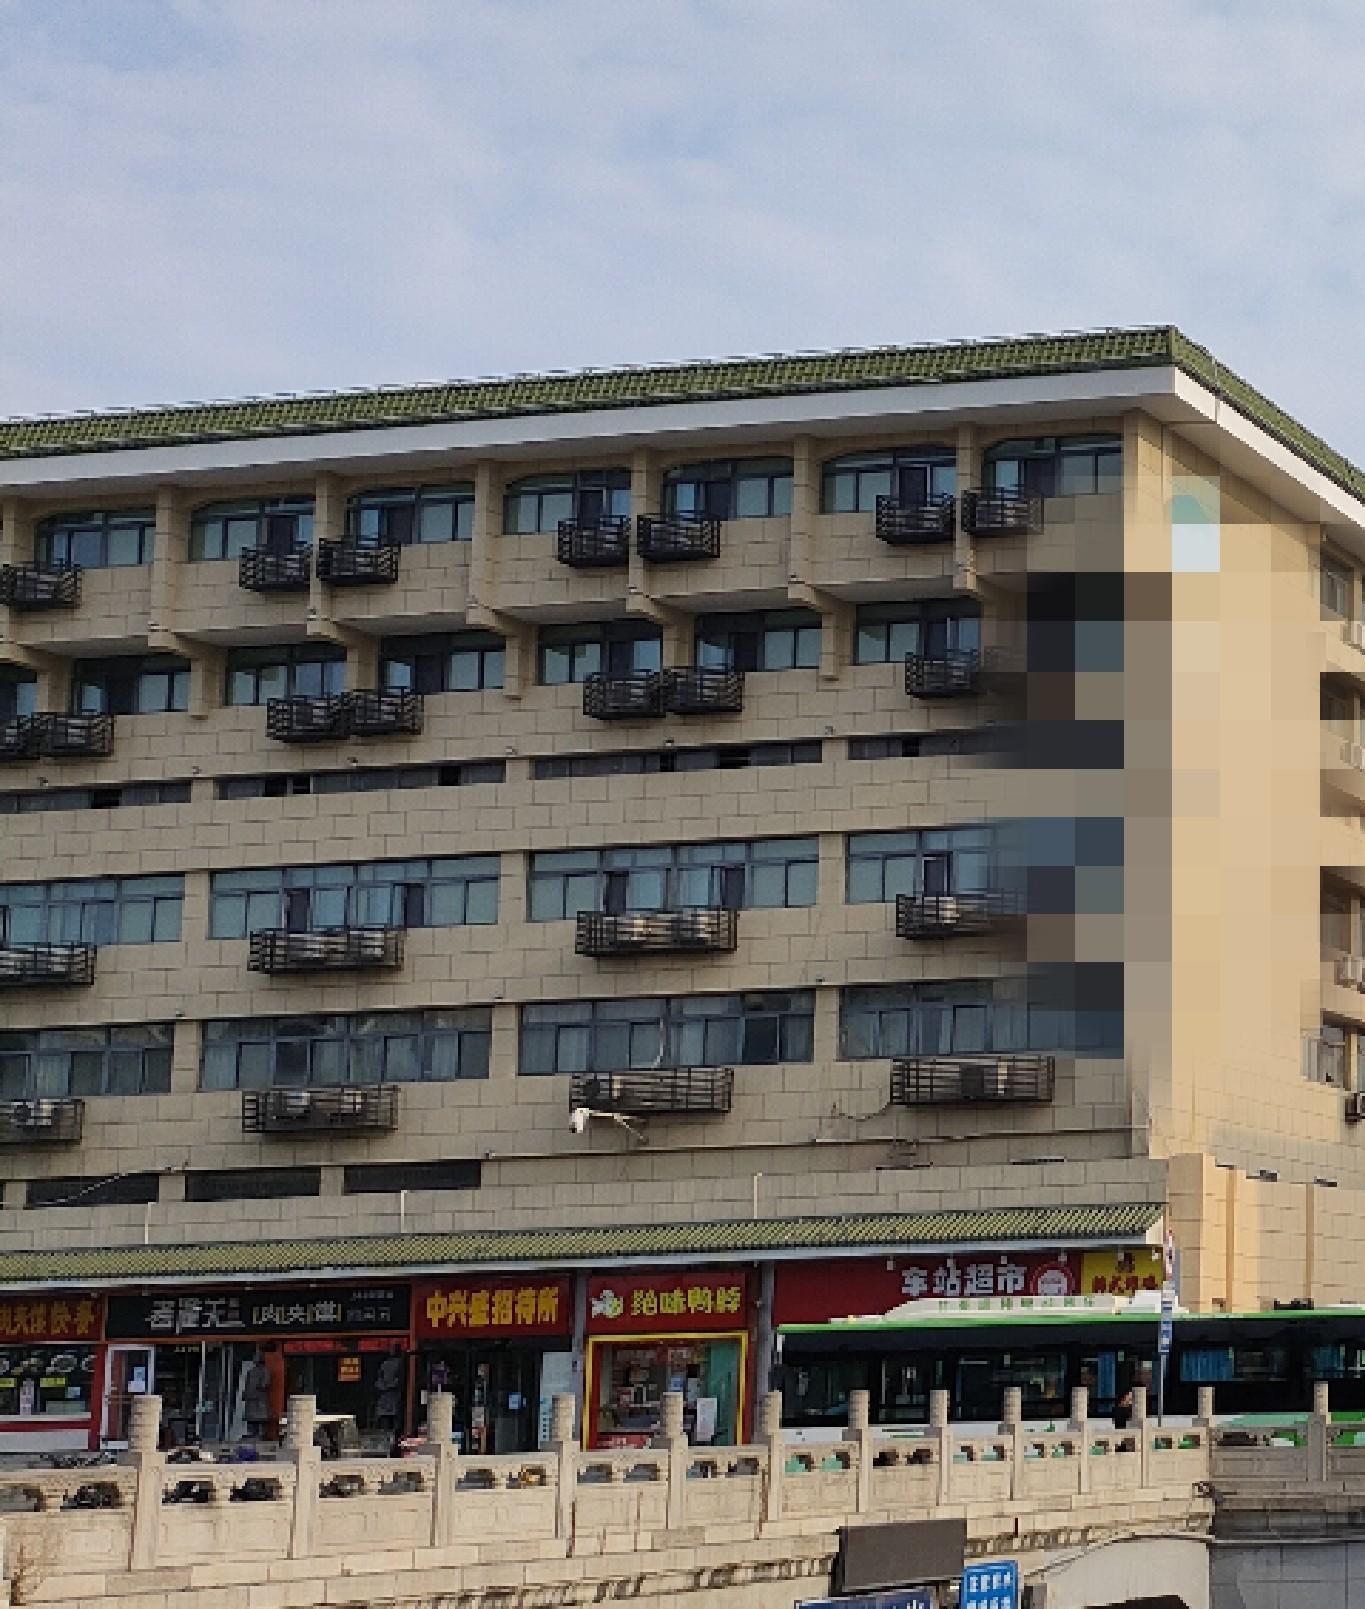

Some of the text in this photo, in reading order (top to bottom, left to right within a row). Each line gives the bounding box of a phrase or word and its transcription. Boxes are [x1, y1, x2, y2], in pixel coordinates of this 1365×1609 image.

[901, 1263, 1028, 1297] 车站超市
[632, 1286, 741, 1317] 绝味鸭脖
